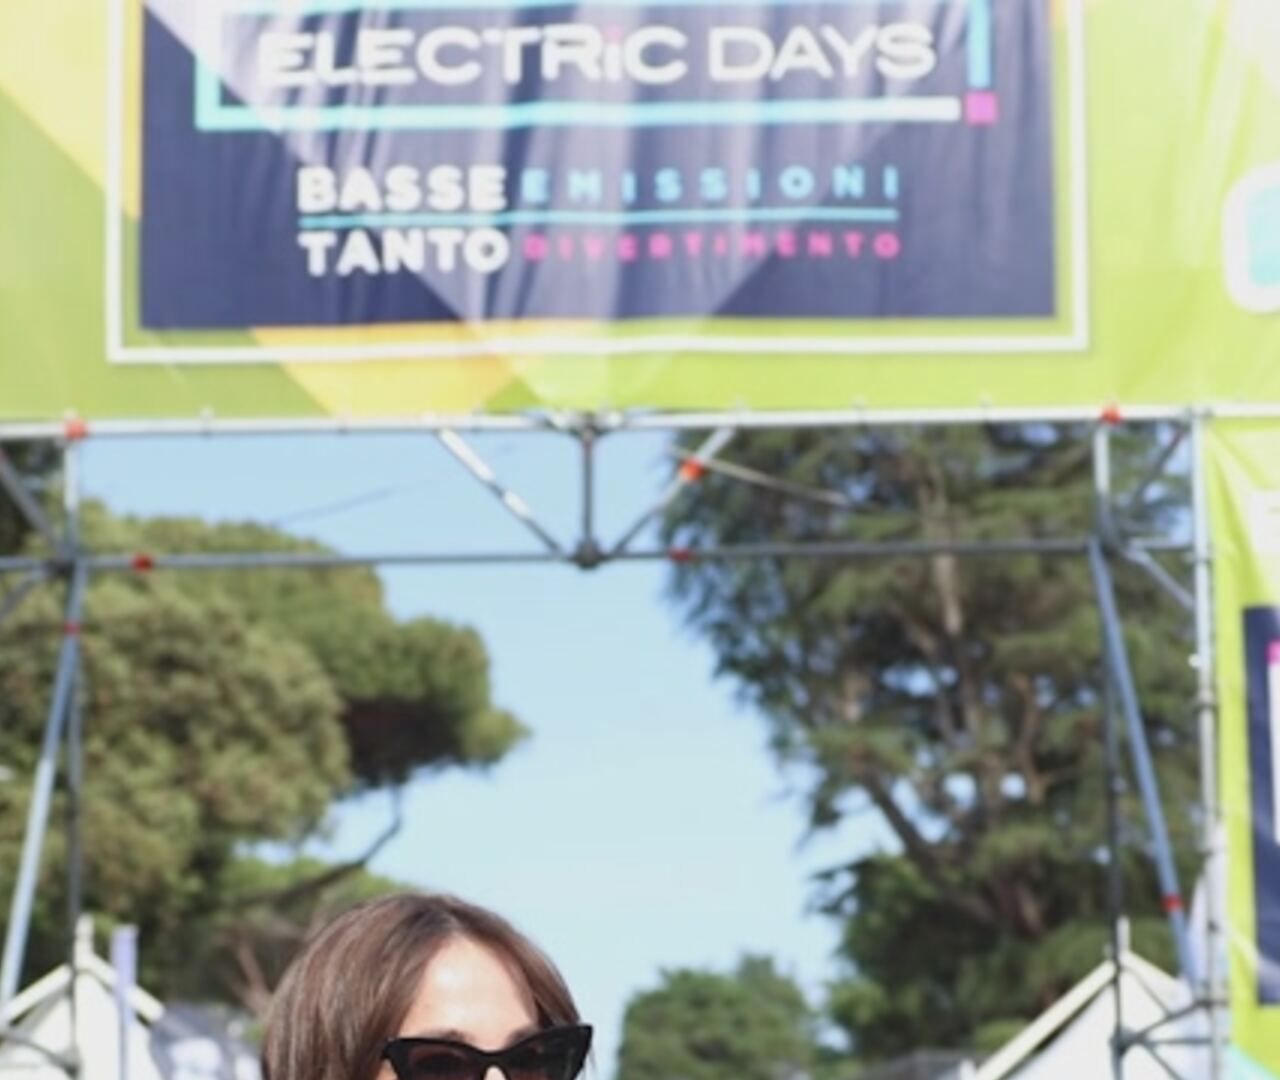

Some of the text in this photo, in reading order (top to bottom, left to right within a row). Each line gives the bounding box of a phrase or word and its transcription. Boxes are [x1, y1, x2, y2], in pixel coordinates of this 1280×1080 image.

[708, 23, 936, 82] DAYS
[297, 165, 899, 213] BASSE EMISSIONI
[297, 228, 901, 276] TANTO DIVERTIMENTO
